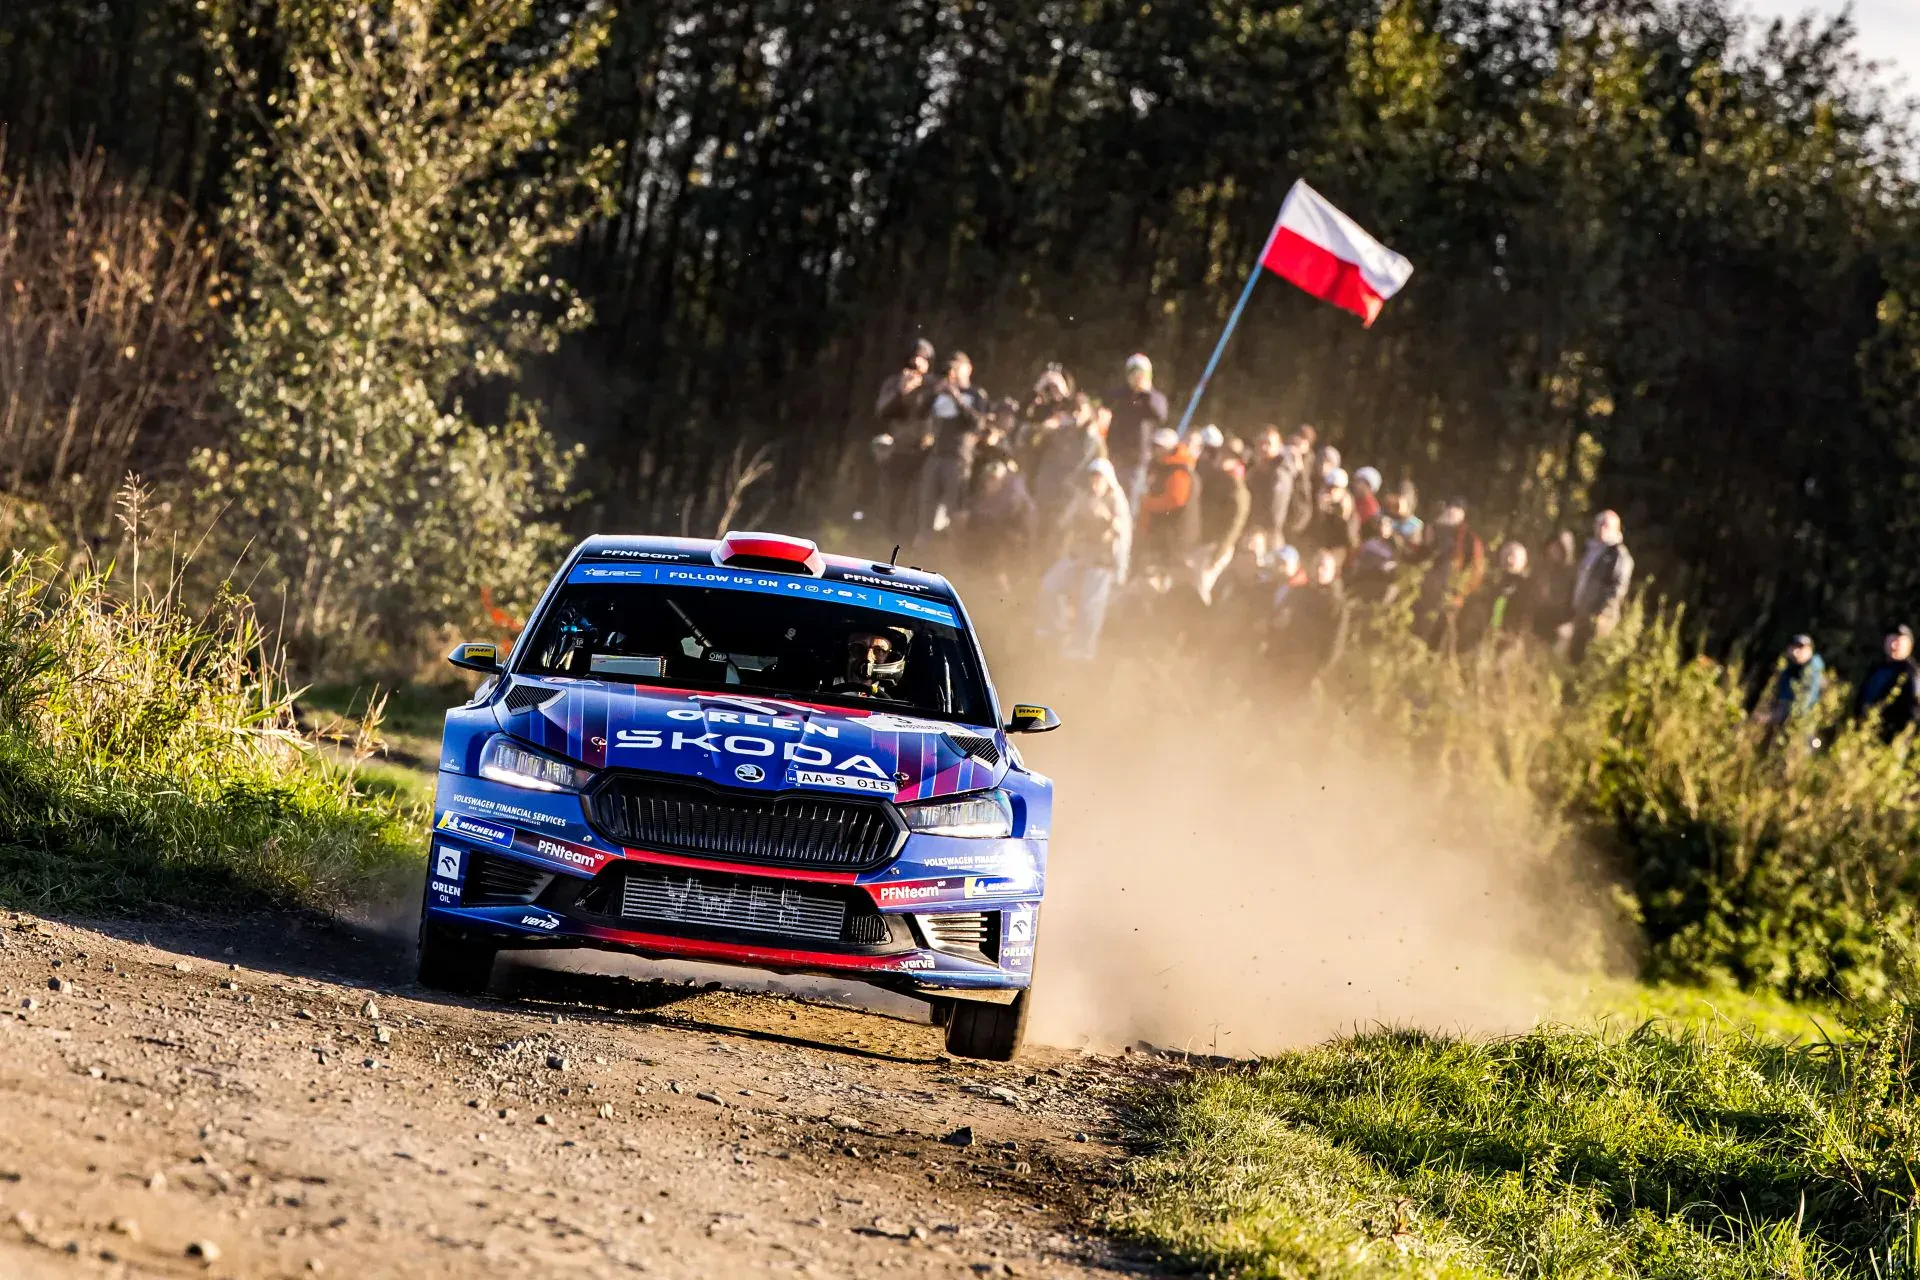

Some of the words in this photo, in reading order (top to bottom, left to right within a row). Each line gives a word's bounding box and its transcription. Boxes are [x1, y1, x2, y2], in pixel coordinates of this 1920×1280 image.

[669, 571, 729, 582] FOLLOW
[734, 577, 753, 585] US
[758, 579, 778, 588] ON
[666, 709, 839, 738] ORLEN
[802, 773, 825, 784] AA
[836, 776, 846, 786] S
[857, 779, 890, 791] 015
[453, 794, 496, 809] VOLKSWAGEN
[495, 802, 532, 819] FINANCIAL
[532, 812, 567, 827] SERVICES
[459, 821, 505, 840] MICHELIN
[923, 855, 973, 867] VOLKSWAGEN
[431, 881, 461, 897] ORLEN
[439, 894, 450, 904] OIL
[521, 915, 560, 930] verva
[1002, 947, 1033, 957] ORLEN
